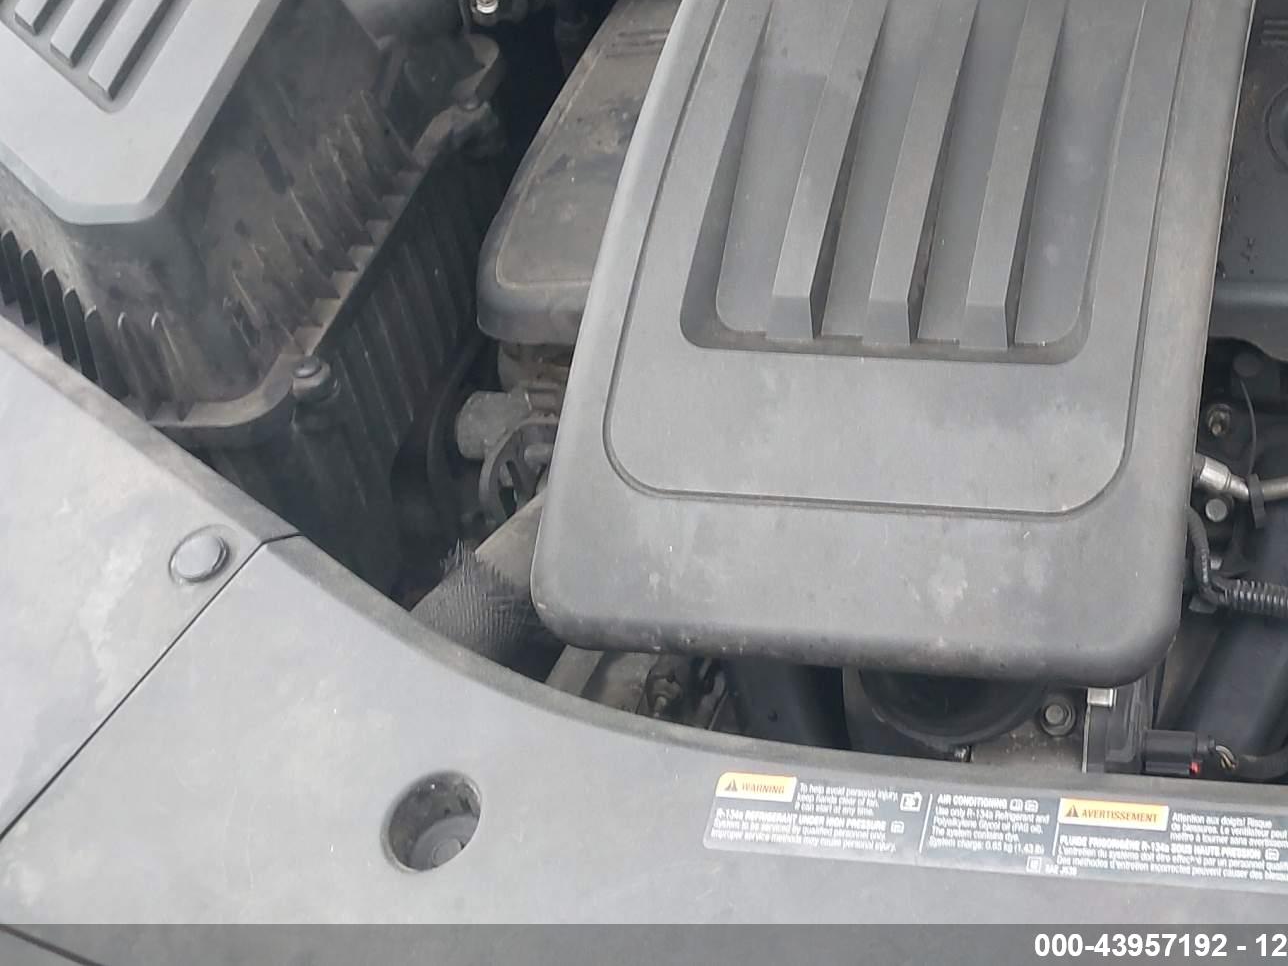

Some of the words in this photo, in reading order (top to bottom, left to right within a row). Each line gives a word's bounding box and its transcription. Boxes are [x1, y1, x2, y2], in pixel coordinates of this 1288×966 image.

[742, 783, 785, 794] WARNING
[937, 794, 952, 805] AIR
[952, 795, 1008, 809] CONDITIONING
[716, 808, 744, 820] R-134a
[744, 810, 798, 825] REFRIGERANT
[798, 814, 825, 826] UNDER
[846, 818, 886, 831] PRESSURE
[966, 809, 994, 819] R-134a
[1081, 808, 1158, 823] AVERTISSEMENT
[1172, 813, 1204, 823] Attention
[1206, 816, 1219, 824] aux
[1247, 818, 1272, 829] Risque
[1141, 841, 1170, 853] R-134a
[1171, 843, 1192, 854] SOUS
[1194, 845, 1220, 856] HAUTE
[1221, 847, 1261, 859] PRESSION
